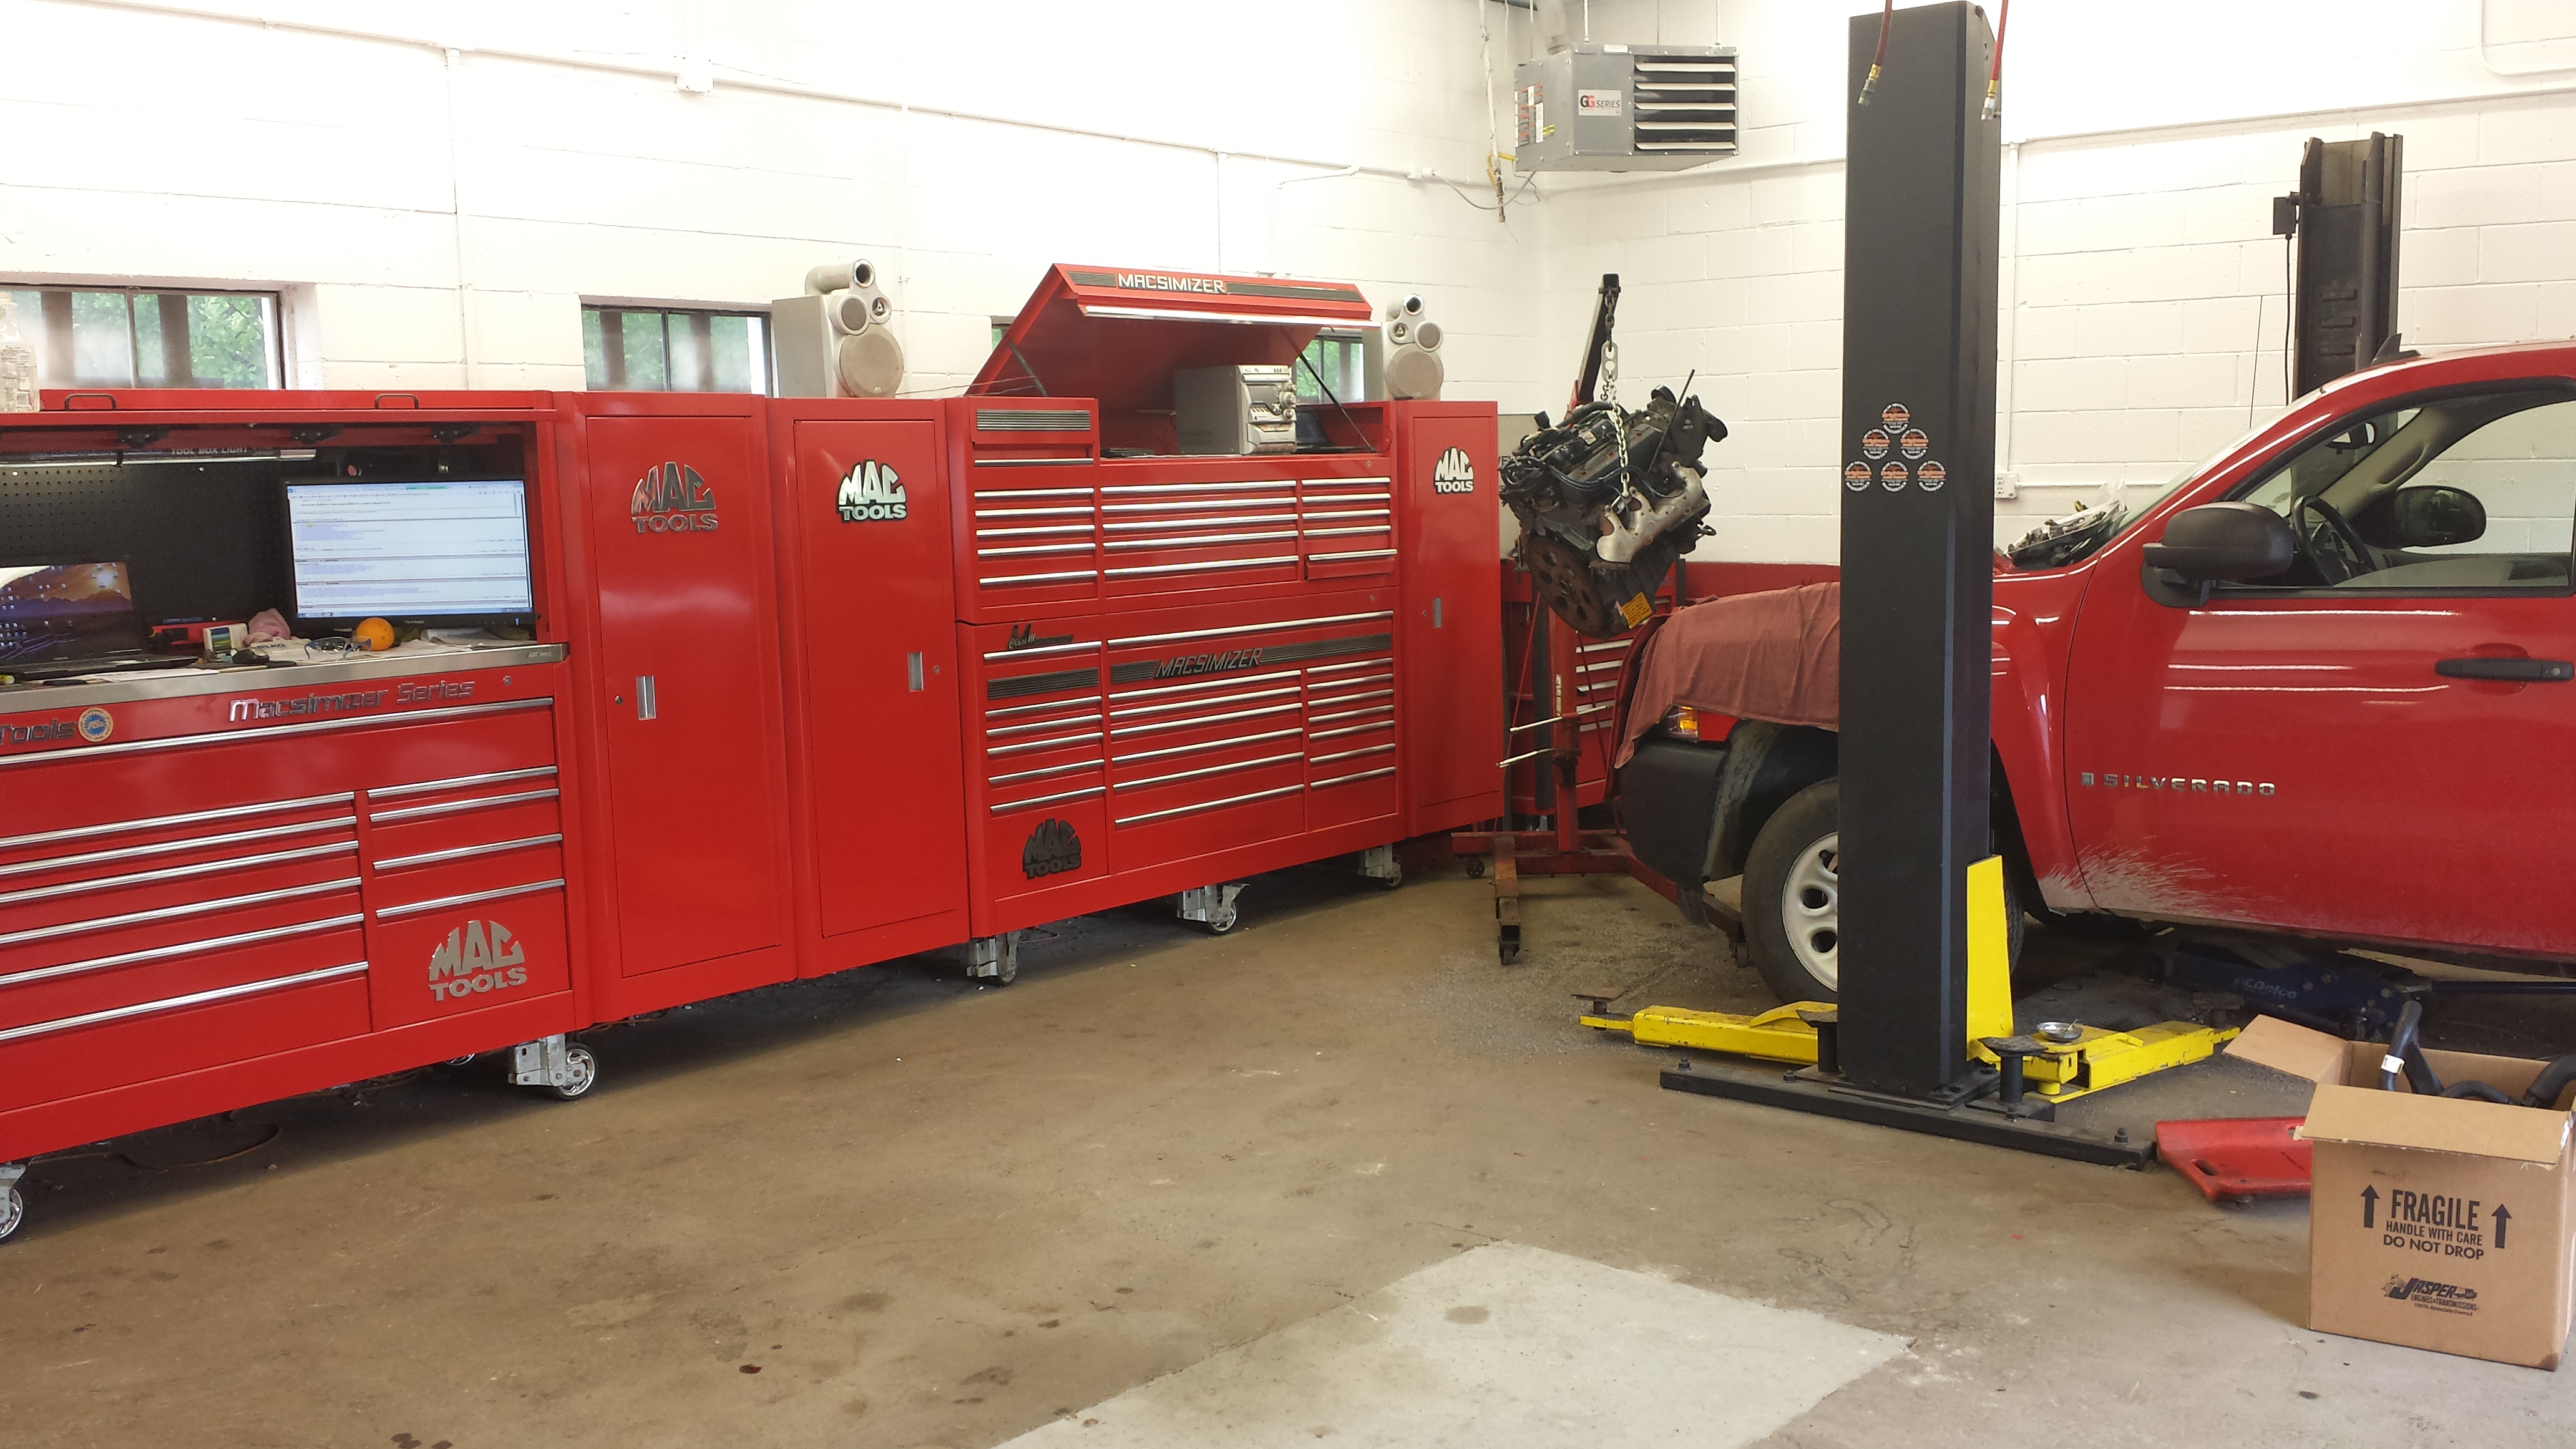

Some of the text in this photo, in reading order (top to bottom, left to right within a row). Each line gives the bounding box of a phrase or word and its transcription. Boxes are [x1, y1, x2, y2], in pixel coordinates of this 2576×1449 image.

[1580, 95, 1621, 108] GG SERIES
[1118, 273, 1226, 293] MACSIMIZER
[1435, 447, 1474, 481] MAC
[631, 461, 716, 514] MAC
[839, 461, 906, 505] MAC
[1435, 481, 1474, 493] TOOLS
[631, 513, 719, 534] TOOLS
[839, 504, 907, 521] TOOLS
[1156, 647, 1263, 678] MACSIMIZER
[396, 681, 475, 704] Series
[2103, 774, 2275, 796] SILVERADO
[1024, 818, 1081, 864] MAC
[1025, 854, 1081, 878] TOOLS
[429, 919, 525, 982] MAC
[429, 967, 527, 1002] TOOLS
[2391, 1189, 2481, 1231] FRAGILE
[2386, 1220, 2483, 1246] HANDLE WITH CARE
[2383, 1234, 2485, 1260] DO NOT DROP
[2389, 1277, 2458, 1300] JASPER
